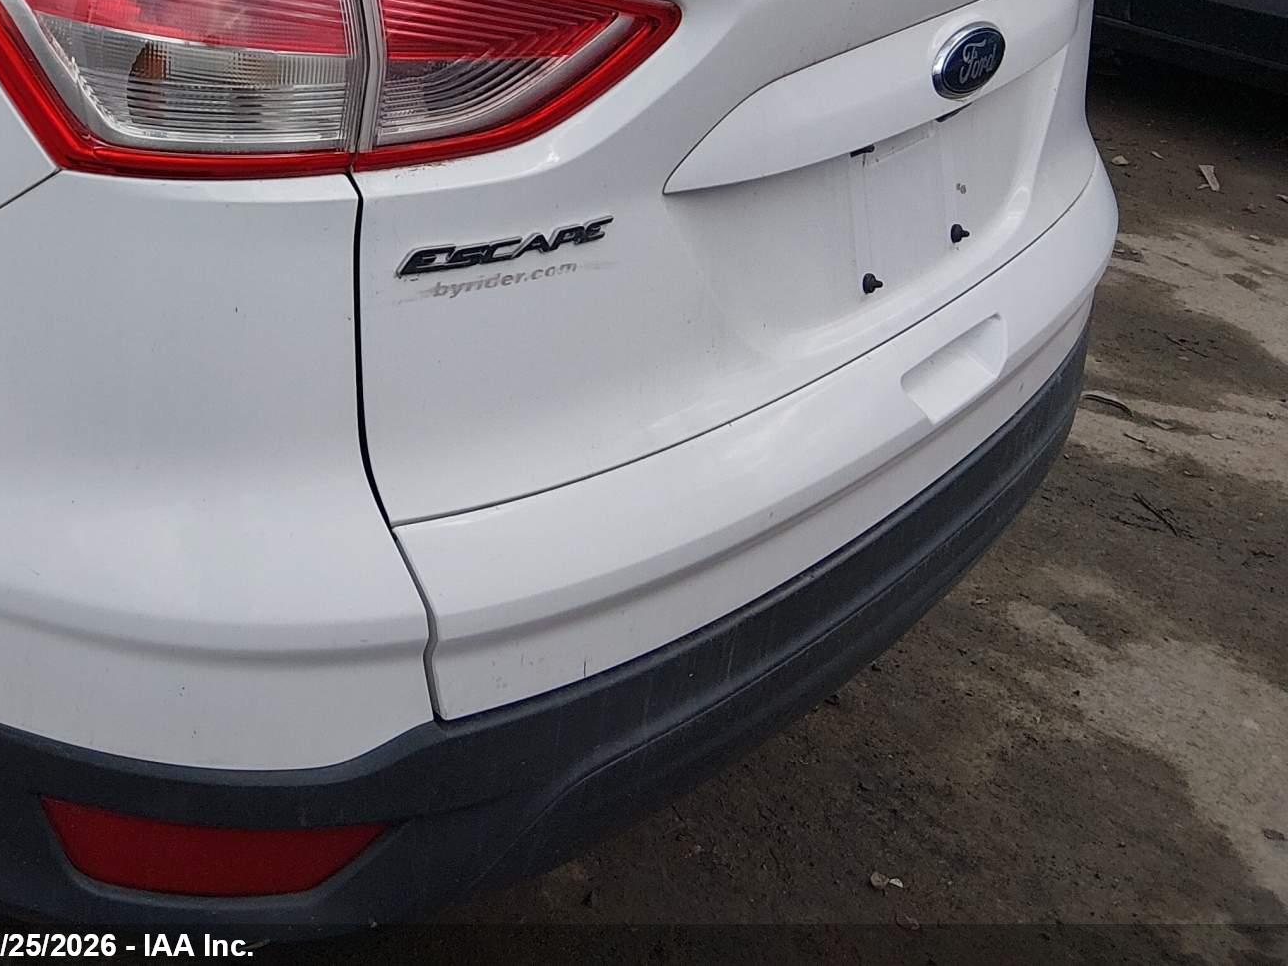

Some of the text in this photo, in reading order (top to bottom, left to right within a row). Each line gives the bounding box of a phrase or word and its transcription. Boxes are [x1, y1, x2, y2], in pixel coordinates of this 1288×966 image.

[959, 38, 997, 84] Ford
[394, 215, 614, 278] ESCAPE
[432, 263, 577, 299] byrider.com
